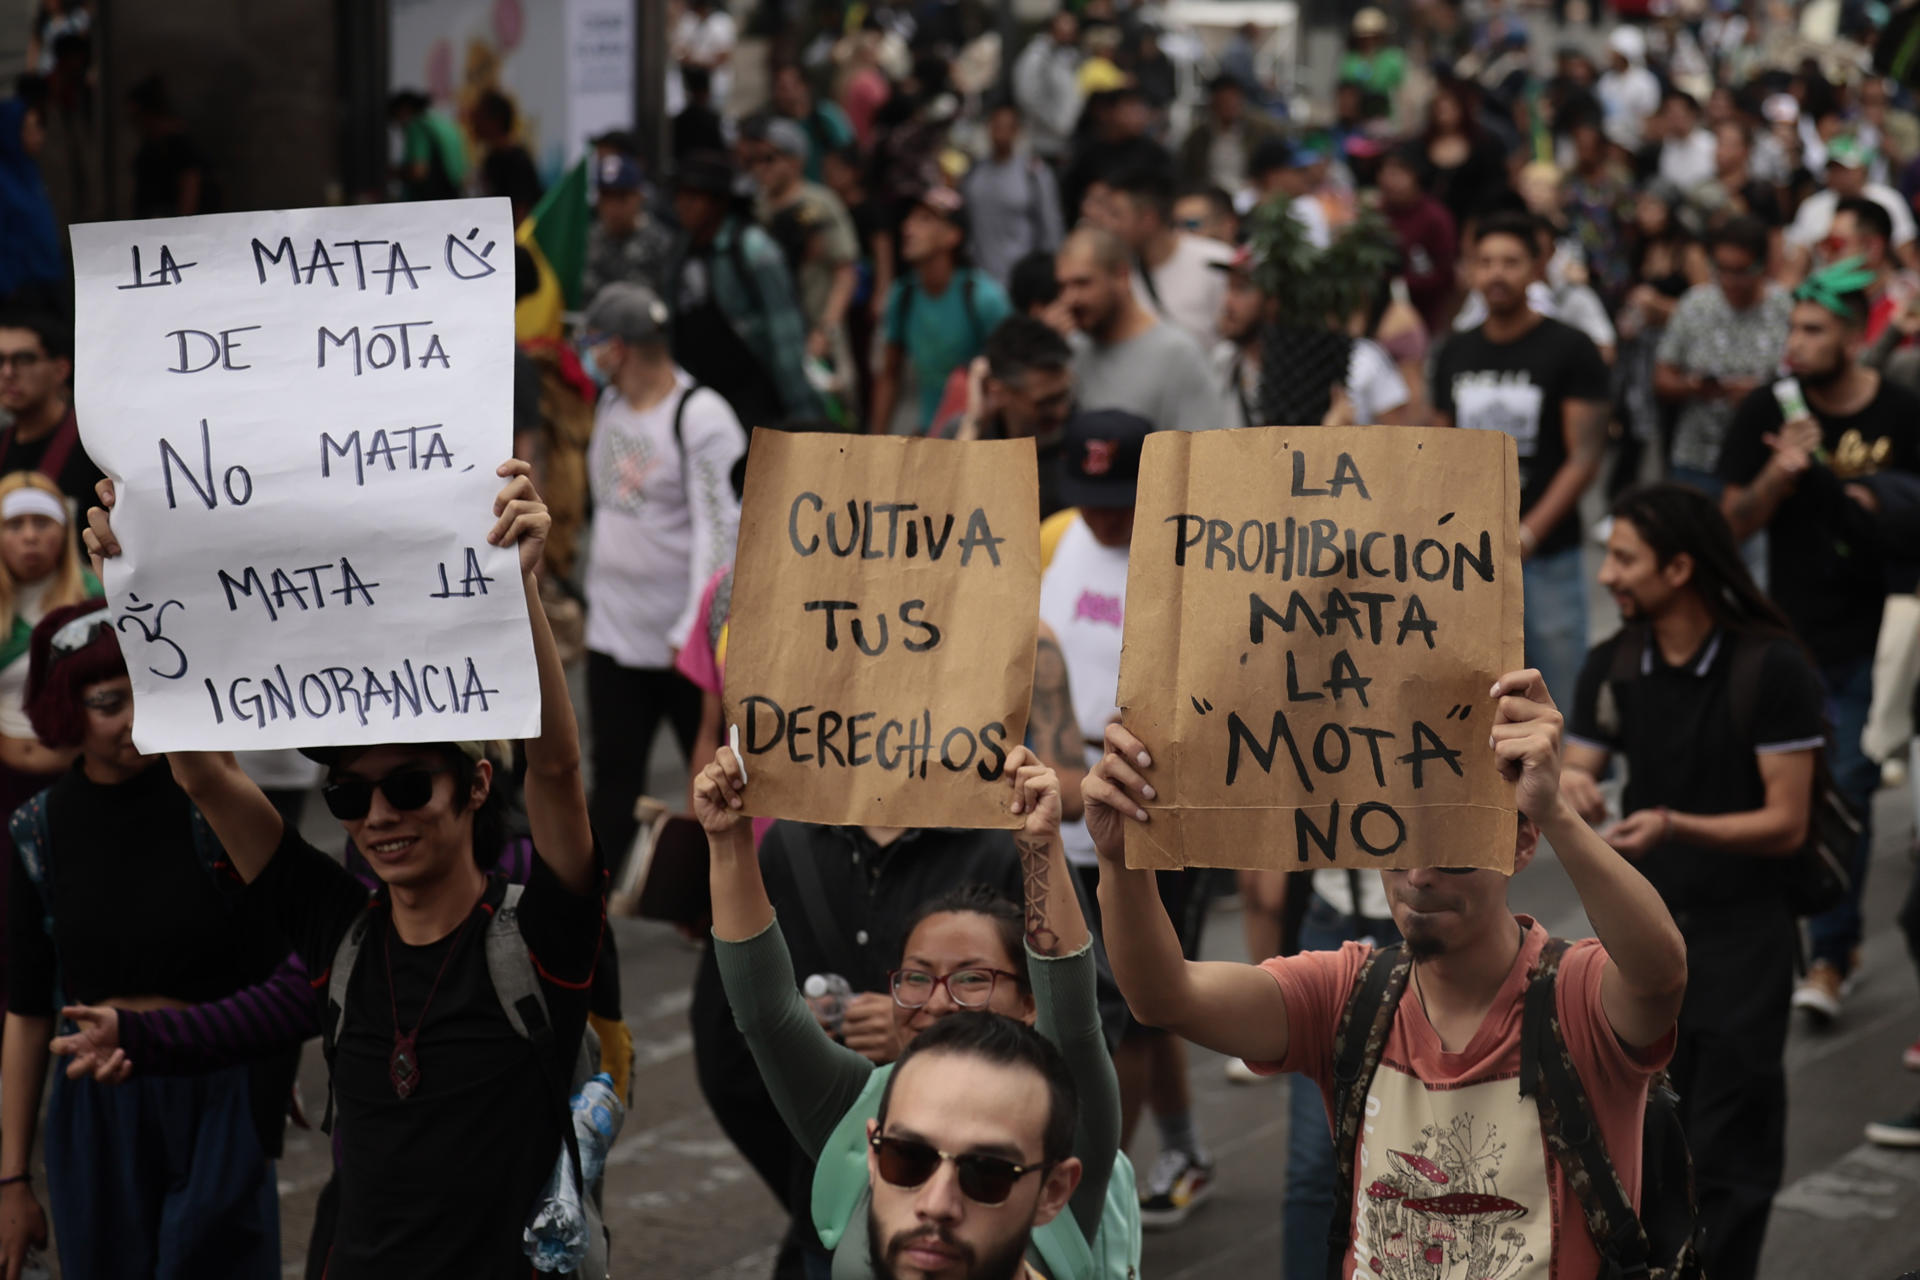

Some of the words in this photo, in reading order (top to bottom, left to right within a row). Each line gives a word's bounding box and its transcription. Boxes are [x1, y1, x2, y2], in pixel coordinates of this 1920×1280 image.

[117, 245, 198, 290] LA
[251, 236, 431, 295] MATA
[165, 325, 262, 374] DE
[318, 321, 450, 376] MOTA
[1291, 451, 1371, 500] LA
[788, 492, 1005, 567] CULTIVA
[1164, 511, 1495, 591] PROHIBICIÓN
[217, 557, 380, 622] MATA
[429, 547, 495, 598] LA
[803, 600, 941, 656] TUS
[1249, 588, 1437, 649] MATA
[204, 657, 499, 729] IGNORANCIA
[1286, 650, 1372, 707] LA
[740, 696, 1007, 781] DERECHOS
[1295, 799, 1407, 862] NO
